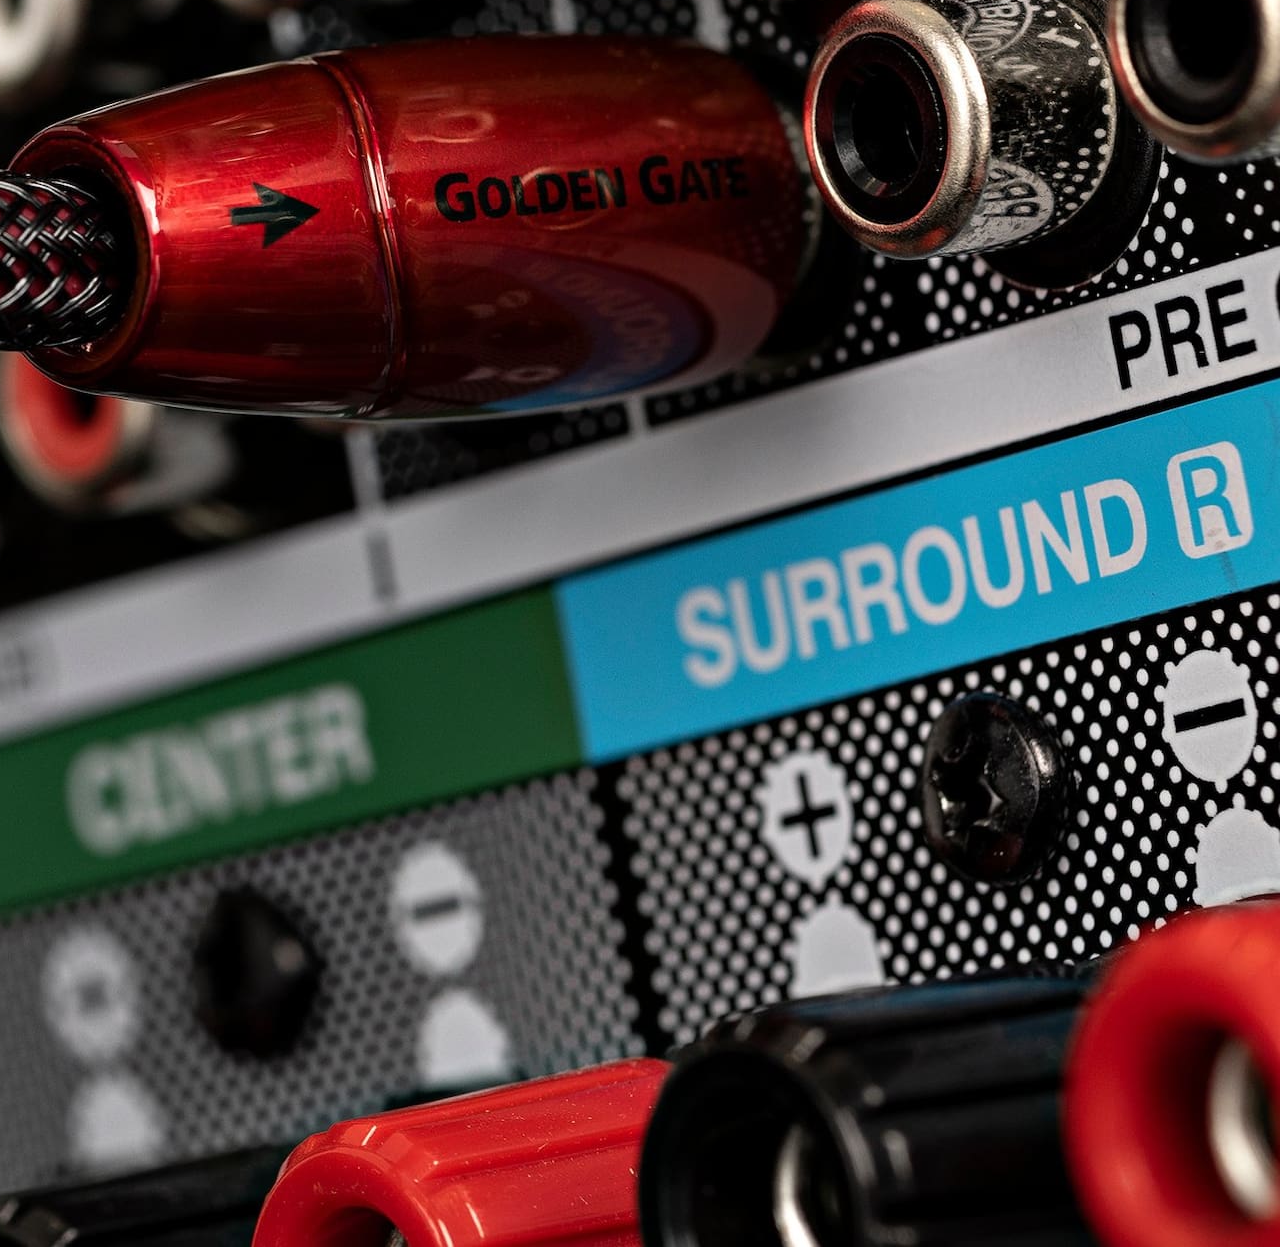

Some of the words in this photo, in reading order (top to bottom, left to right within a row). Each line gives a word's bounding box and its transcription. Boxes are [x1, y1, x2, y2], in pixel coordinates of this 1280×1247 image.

[434, 166, 628, 223] GOLDEN
[638, 155, 750, 206] GATE
[1108, 278, 1258, 391] PRE
[677, 478, 1148, 688] SURROUND
[1174, 451, 1248, 553] R
[65, 682, 374, 851] CENTER
